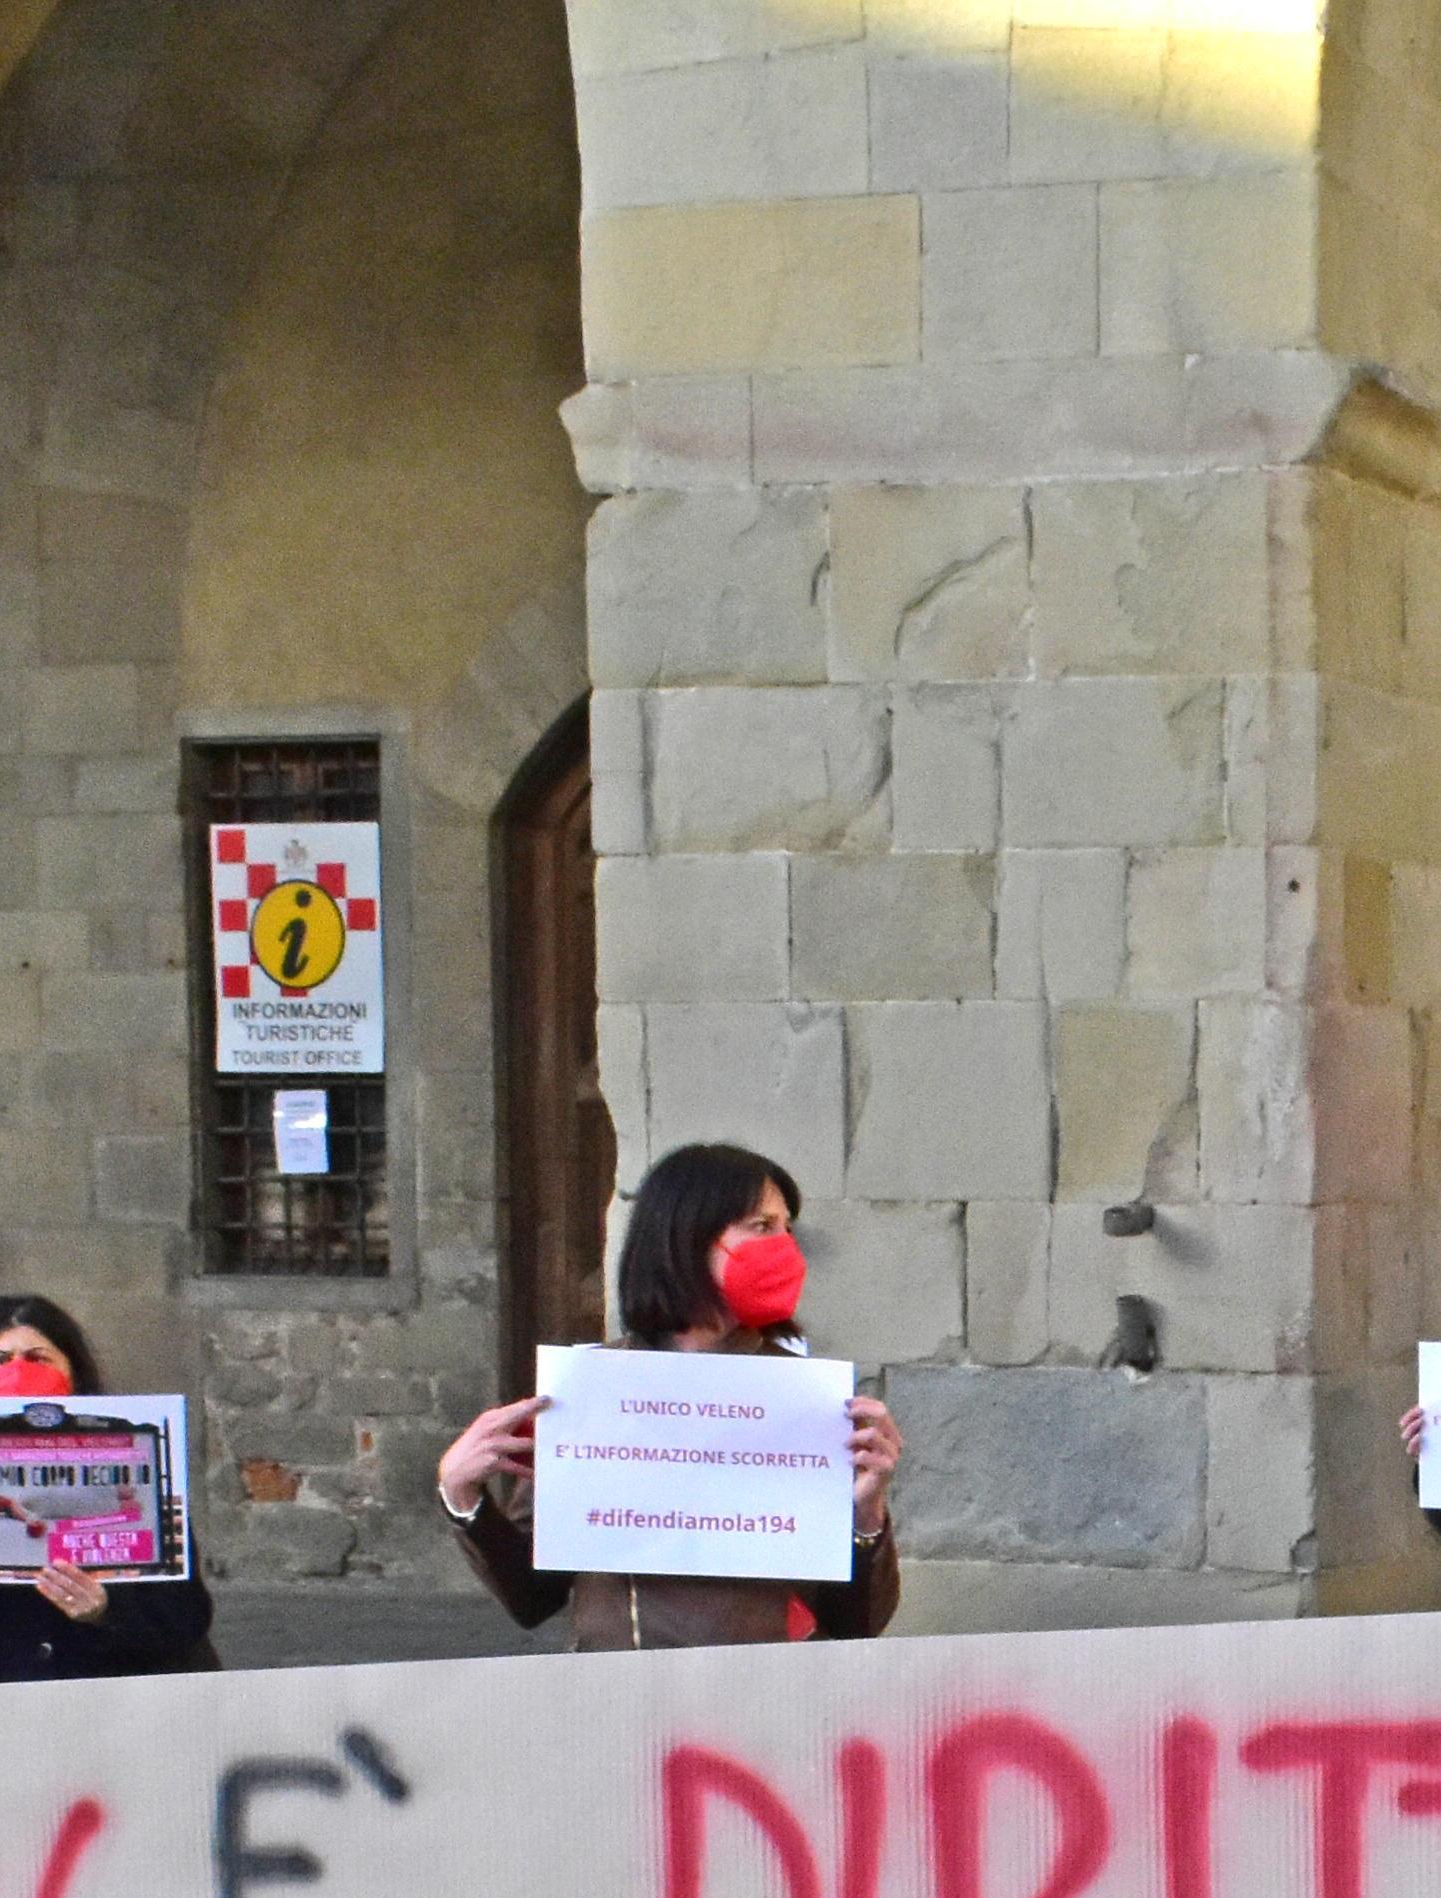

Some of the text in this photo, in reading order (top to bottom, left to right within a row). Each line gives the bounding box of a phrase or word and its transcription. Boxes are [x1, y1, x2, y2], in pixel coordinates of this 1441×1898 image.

[233, 1002, 367, 1019] INFORMAZIONI
[246, 1025, 354, 1041] TURISTICHE
[232, 1050, 362, 1065] TOURIST OFFICE
[620, 1399, 765, 1420] L'UNICO VELENO
[555, 1444, 830, 1469] E' L'INFORMAZIONE SCORRETTA
[587, 1508, 796, 1534] #difendiamola194
